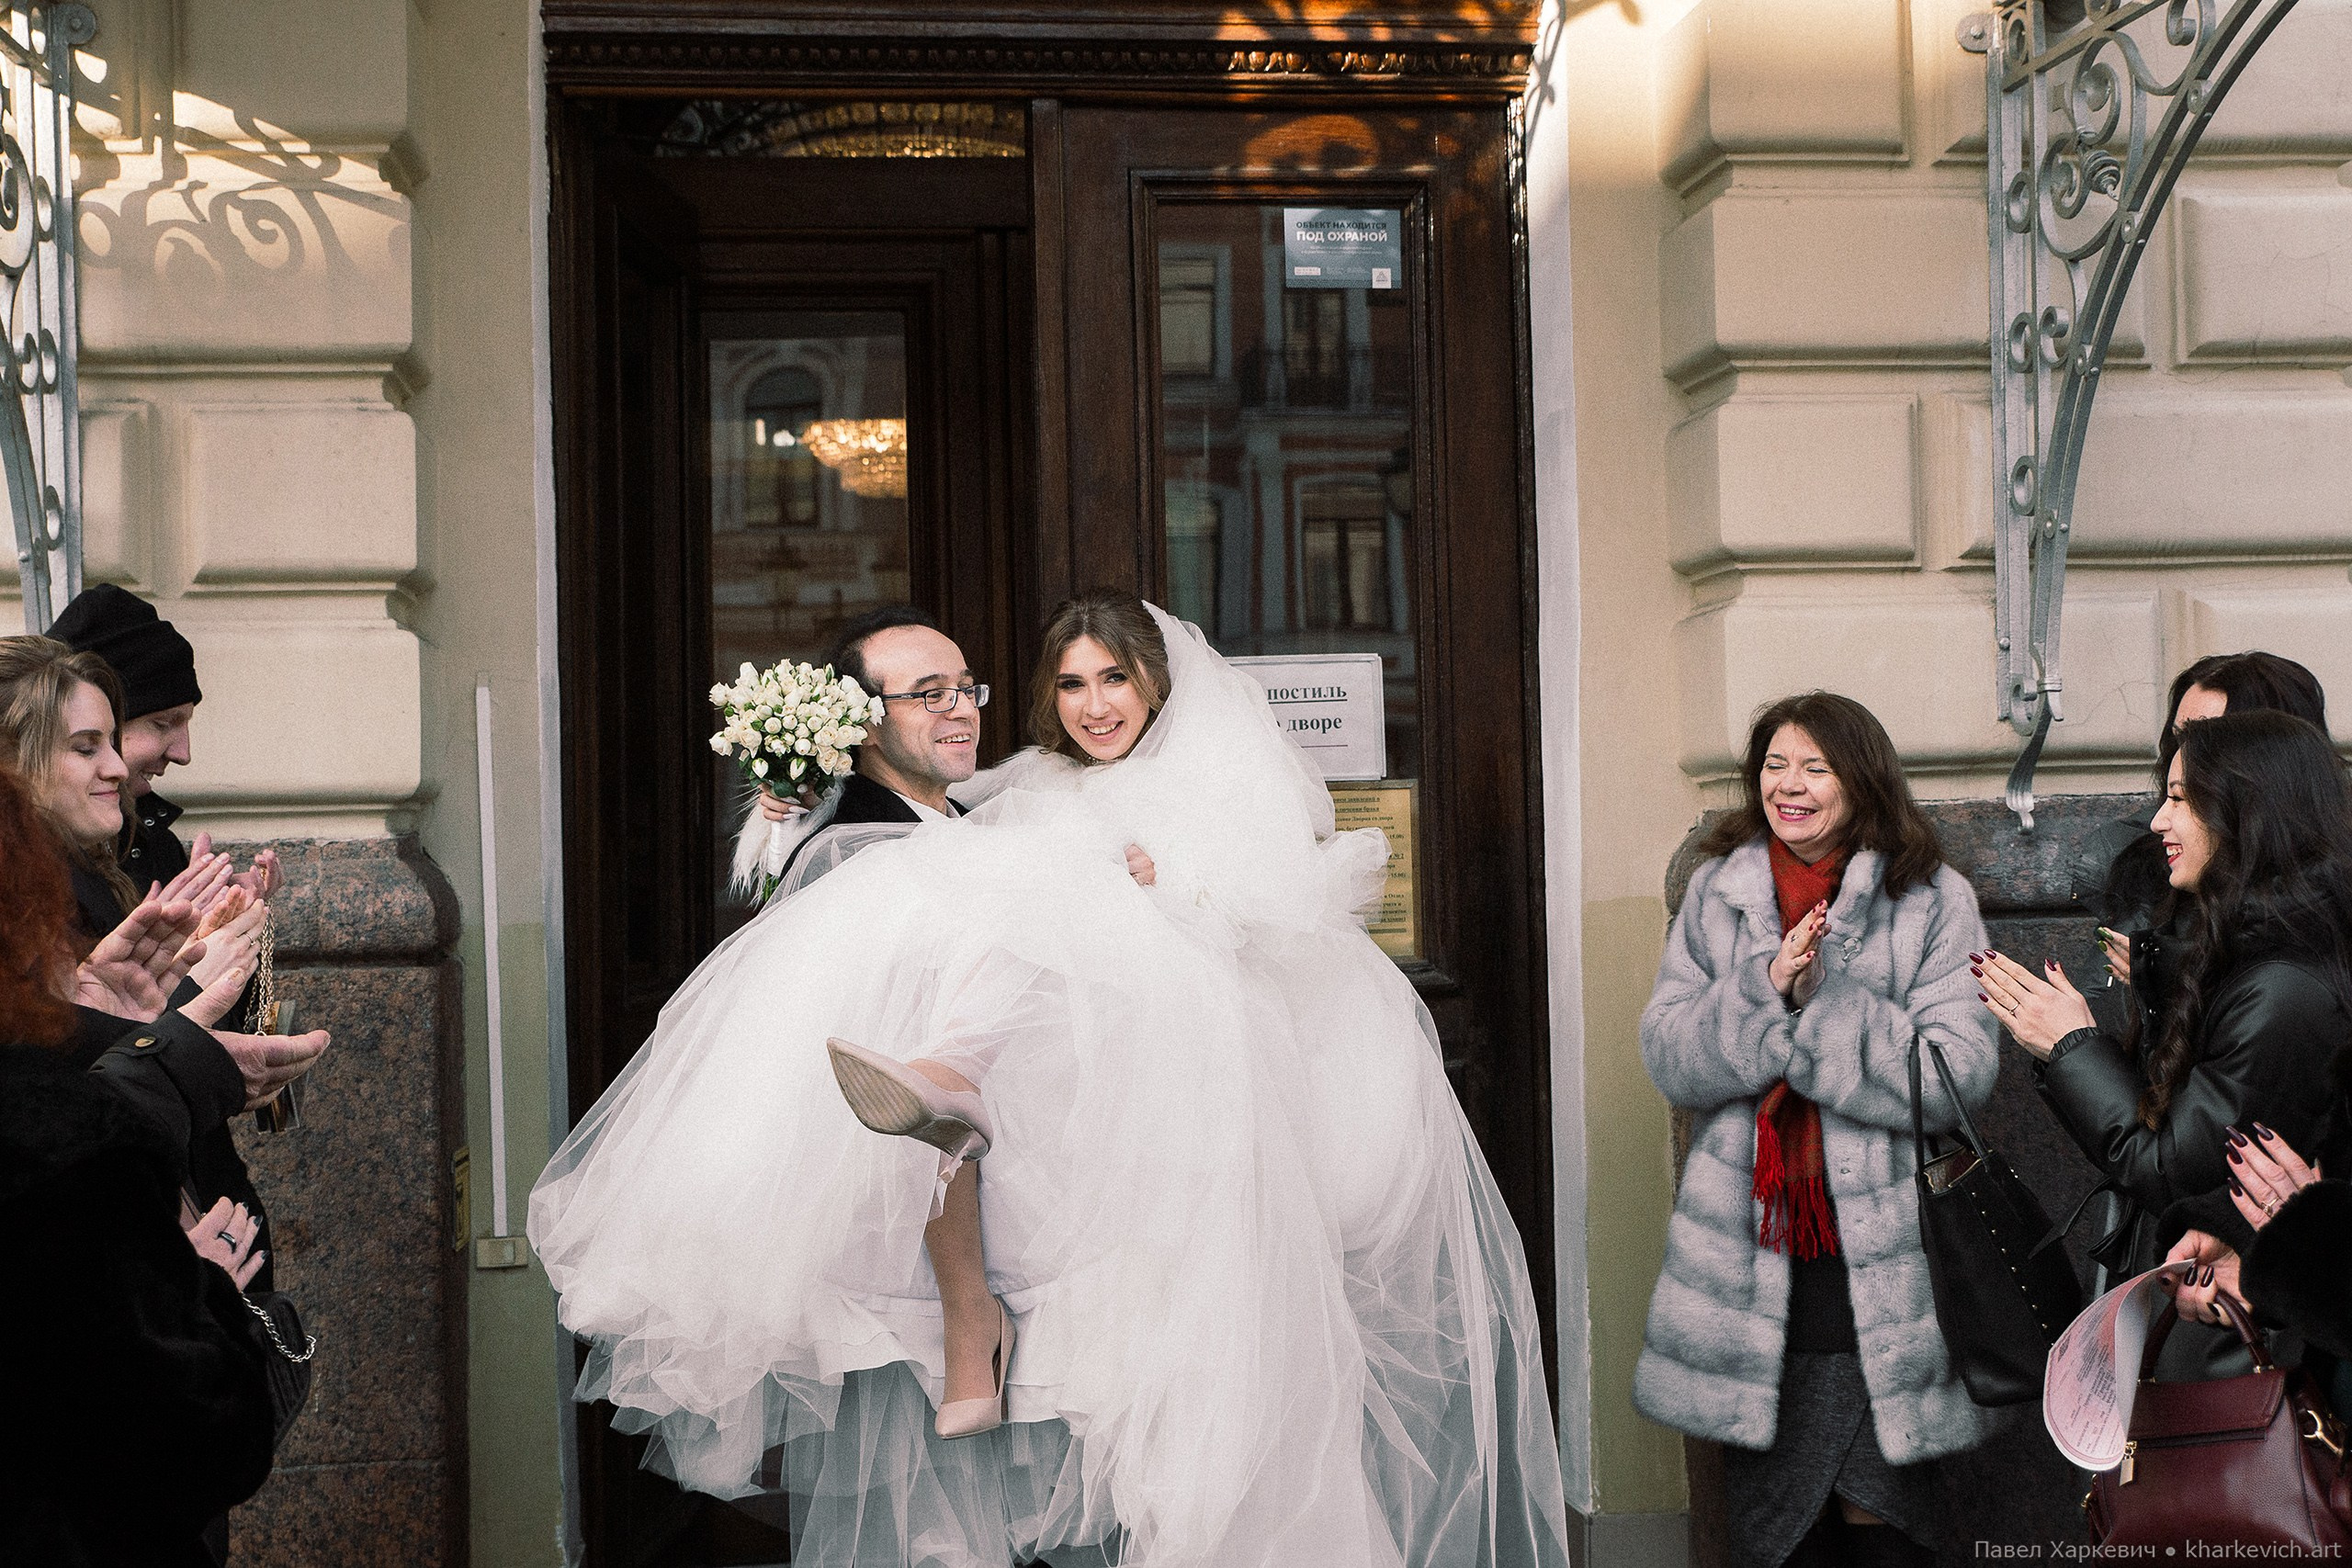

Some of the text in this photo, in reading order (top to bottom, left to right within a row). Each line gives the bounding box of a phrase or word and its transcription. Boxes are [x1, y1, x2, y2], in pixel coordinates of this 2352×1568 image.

[1296, 231, 1387, 243] ПОД ОХРАНОЙ
[1267, 686, 1347, 700] постиль
[1286, 717, 1342, 734] дворе
